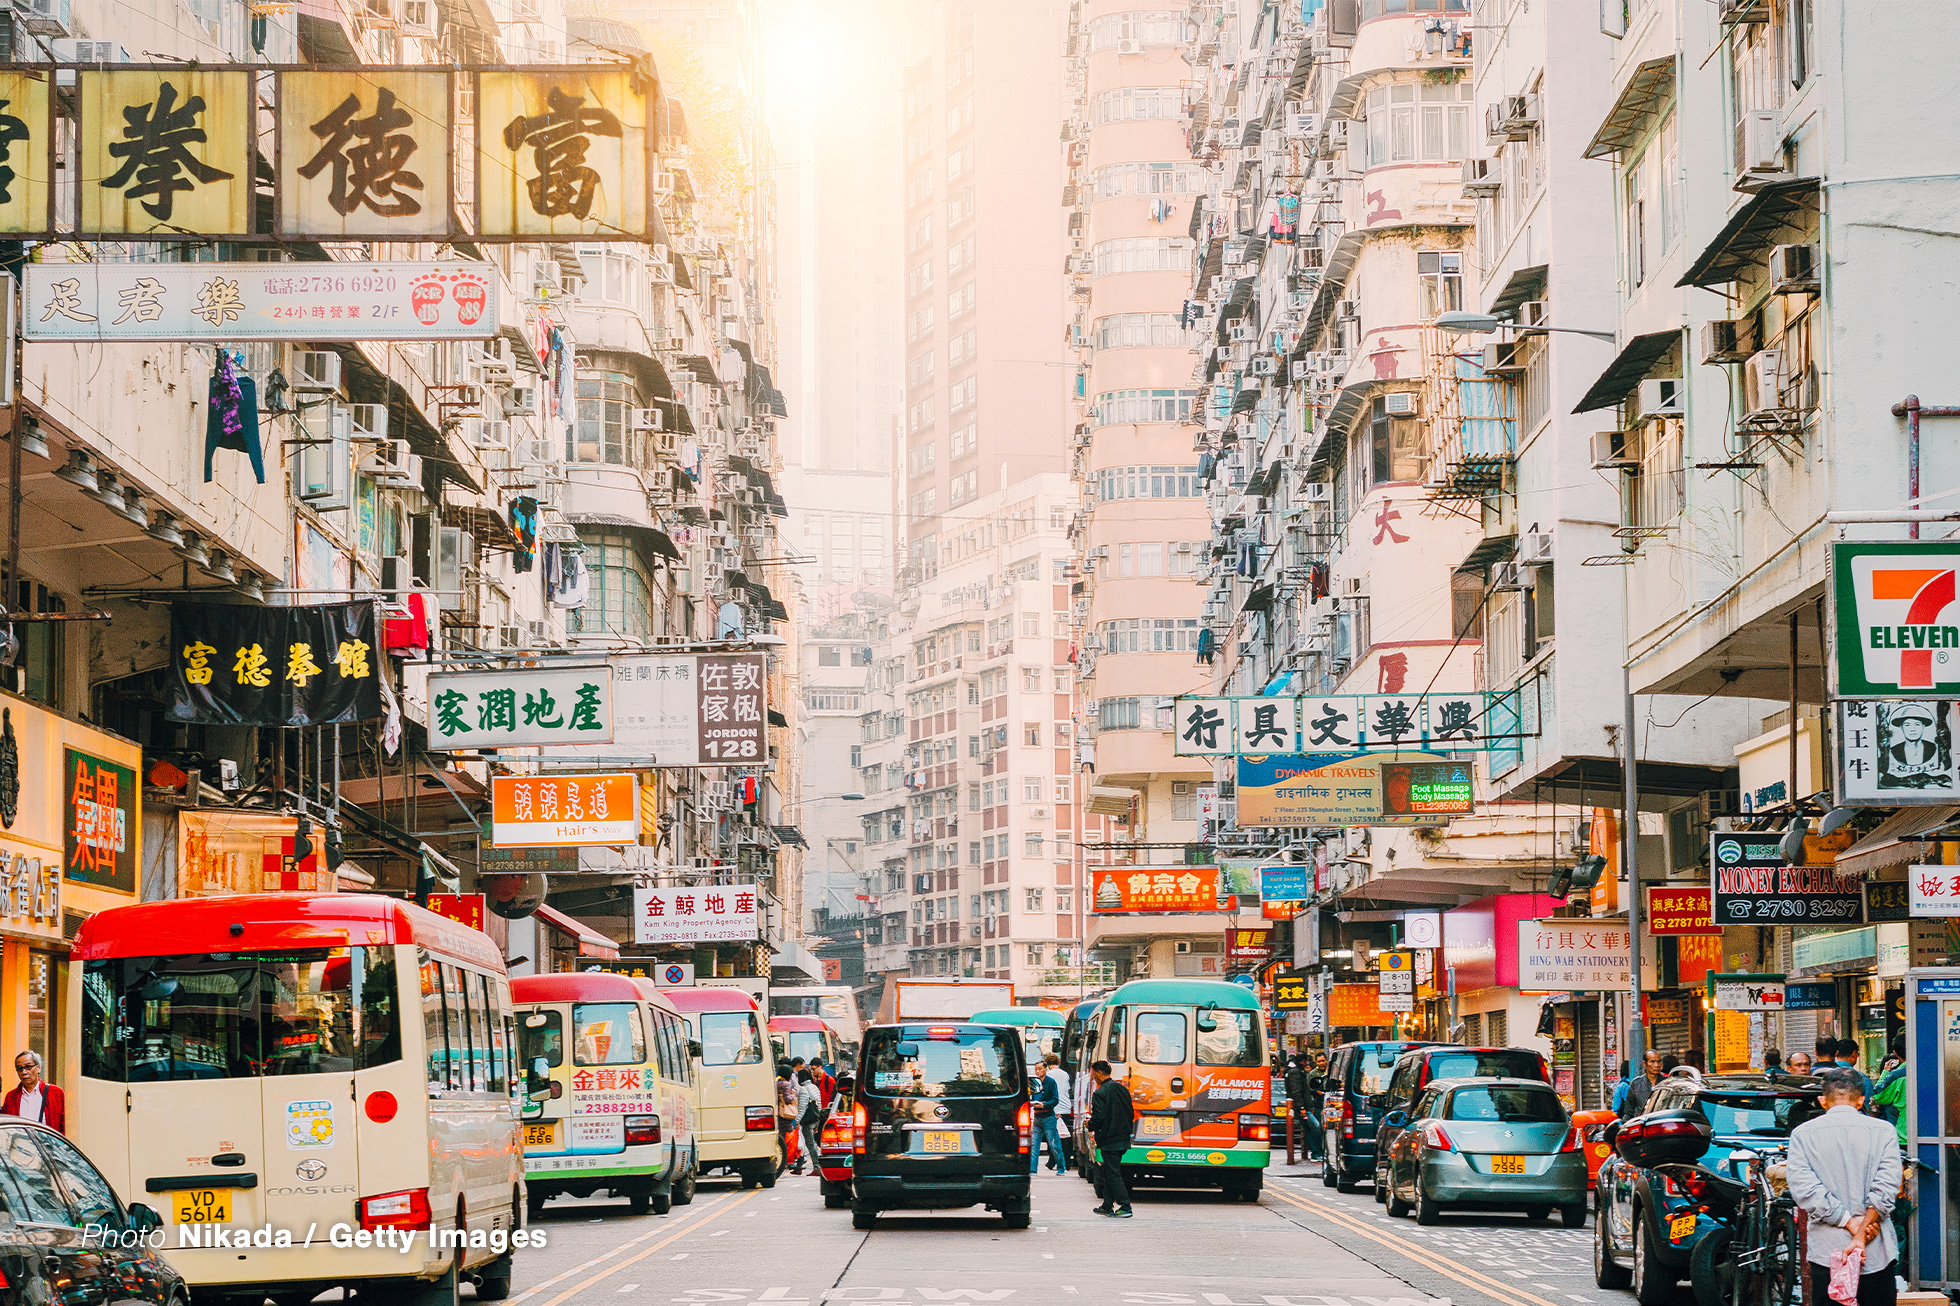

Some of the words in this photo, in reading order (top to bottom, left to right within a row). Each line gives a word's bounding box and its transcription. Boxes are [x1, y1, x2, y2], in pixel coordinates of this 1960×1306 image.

[351, 275, 397, 292] 6920
[273, 305, 361, 319] 24小時營業
[372, 304, 399, 318] 2/F
[1872, 569, 1956, 688] 7
[183, 639, 371, 688] 富德拳館
[617, 664, 690, 682] 雅蘭床褥
[700, 663, 760, 691] 佐敦
[435, 682, 603, 738] 家潤地產
[704, 728, 757, 739] JORDON
[704, 741, 757, 757] 128
[1274, 768, 1329, 779] DYNAMIC
[1330, 767, 1375, 778] TRAVELS
[1274, 784, 1330, 799] डाइनामिक
[1411, 785, 1431, 793] Foot
[1433, 784, 1469, 794] Massage
[1412, 792, 1432, 802] Body
[1434, 792, 1469, 802] Massage
[1308, 806, 1334, 814] Shanghai
[556, 825, 598, 837] Hair's
[602, 825, 622, 835] Way
[1718, 867, 1774, 894] MONEY
[645, 892, 755, 917] 金鯨地產
[1756, 899, 1806, 917] 2780
[1809, 899, 1859, 917] 3287
[663, 919, 679, 929] King
[682, 919, 713, 928] Property
[715, 918, 742, 926] Agency
[1667, 918, 1693, 928] 2787
[1529, 956, 1551, 967] HING
[1555, 956, 1574, 967] WAH
[1577, 956, 1630, 967] STATIONERY
[573, 1069, 640, 1091] 金寶來
[1210, 1079, 1265, 1089] LALAMOVE
[585, 1103, 653, 1114] 23882918
[530, 1127, 546, 1135] FG
[1146, 1125, 1173, 1133] 3493
[524, 1135, 552, 1144] 1566
[933, 1133, 950, 1141] ML
[925, 1142, 959, 1151] 3858
[1167, 1151, 1185, 1159] 2751
[1187, 1152, 1207, 1160] 6666
[1493, 1164, 1524, 1173] 7995
[267, 1184, 356, 1197] COASTER
[190, 1190, 215, 1207] VD
[180, 1205, 225, 1222] 5614
[1677, 1217, 1690, 1227] PP
[1671, 1225, 1694, 1239] 6829
[676, 1288, 1017, 1301] SLOW
